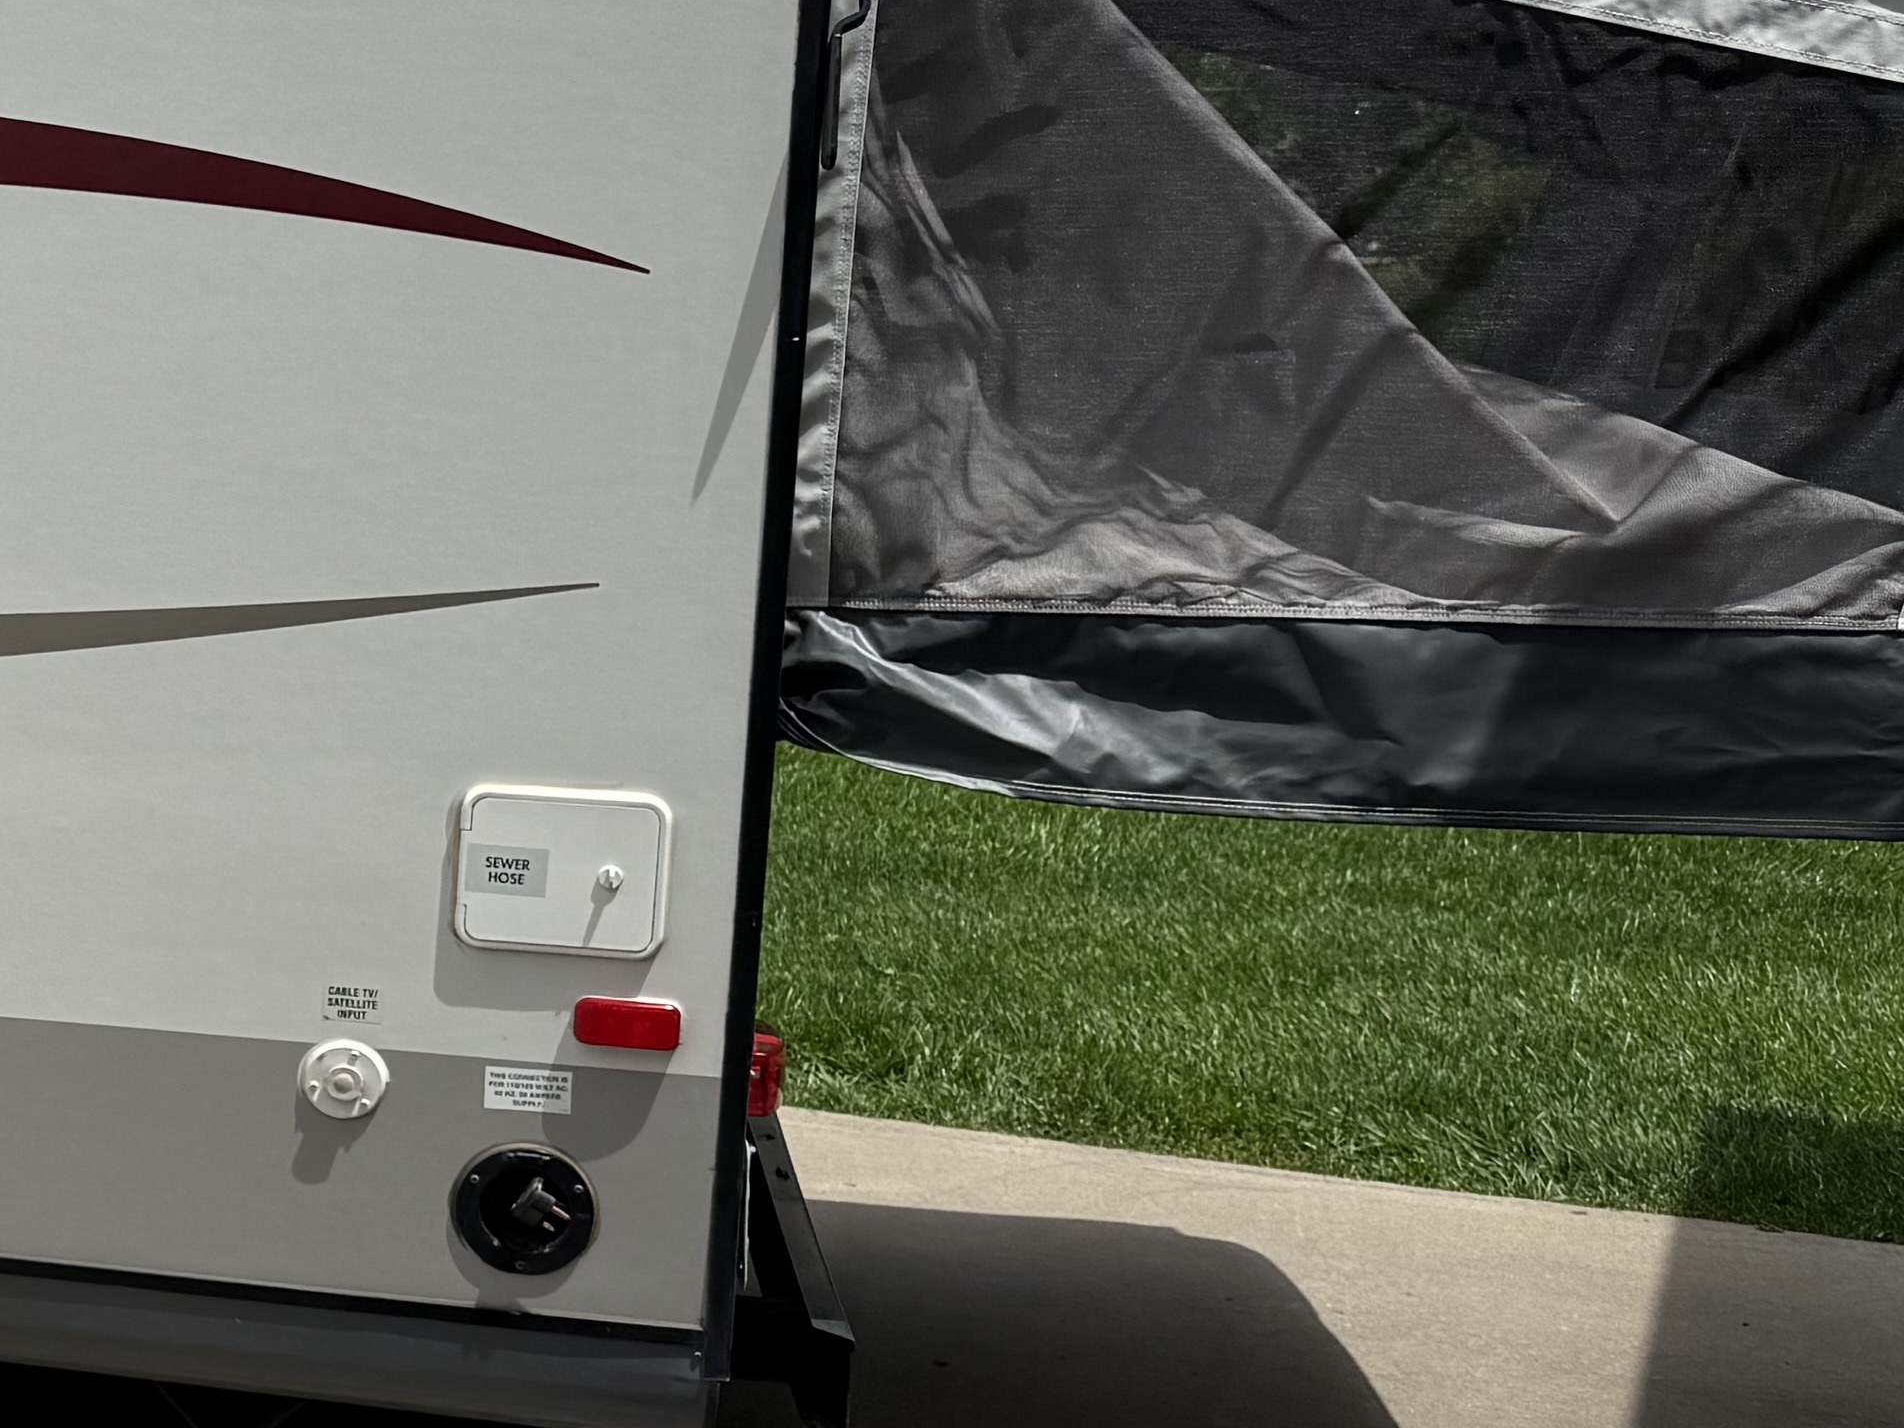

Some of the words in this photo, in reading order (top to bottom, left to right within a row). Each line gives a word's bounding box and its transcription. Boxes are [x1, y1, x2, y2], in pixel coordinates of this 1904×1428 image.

[485, 856, 530, 871] SEWER
[488, 871, 525, 885] HOSE
[328, 986, 359, 997] CABLE
[363, 988, 378, 998] TV/
[327, 997, 378, 1010] SATELLITE
[337, 1009, 367, 1020] INPUT
